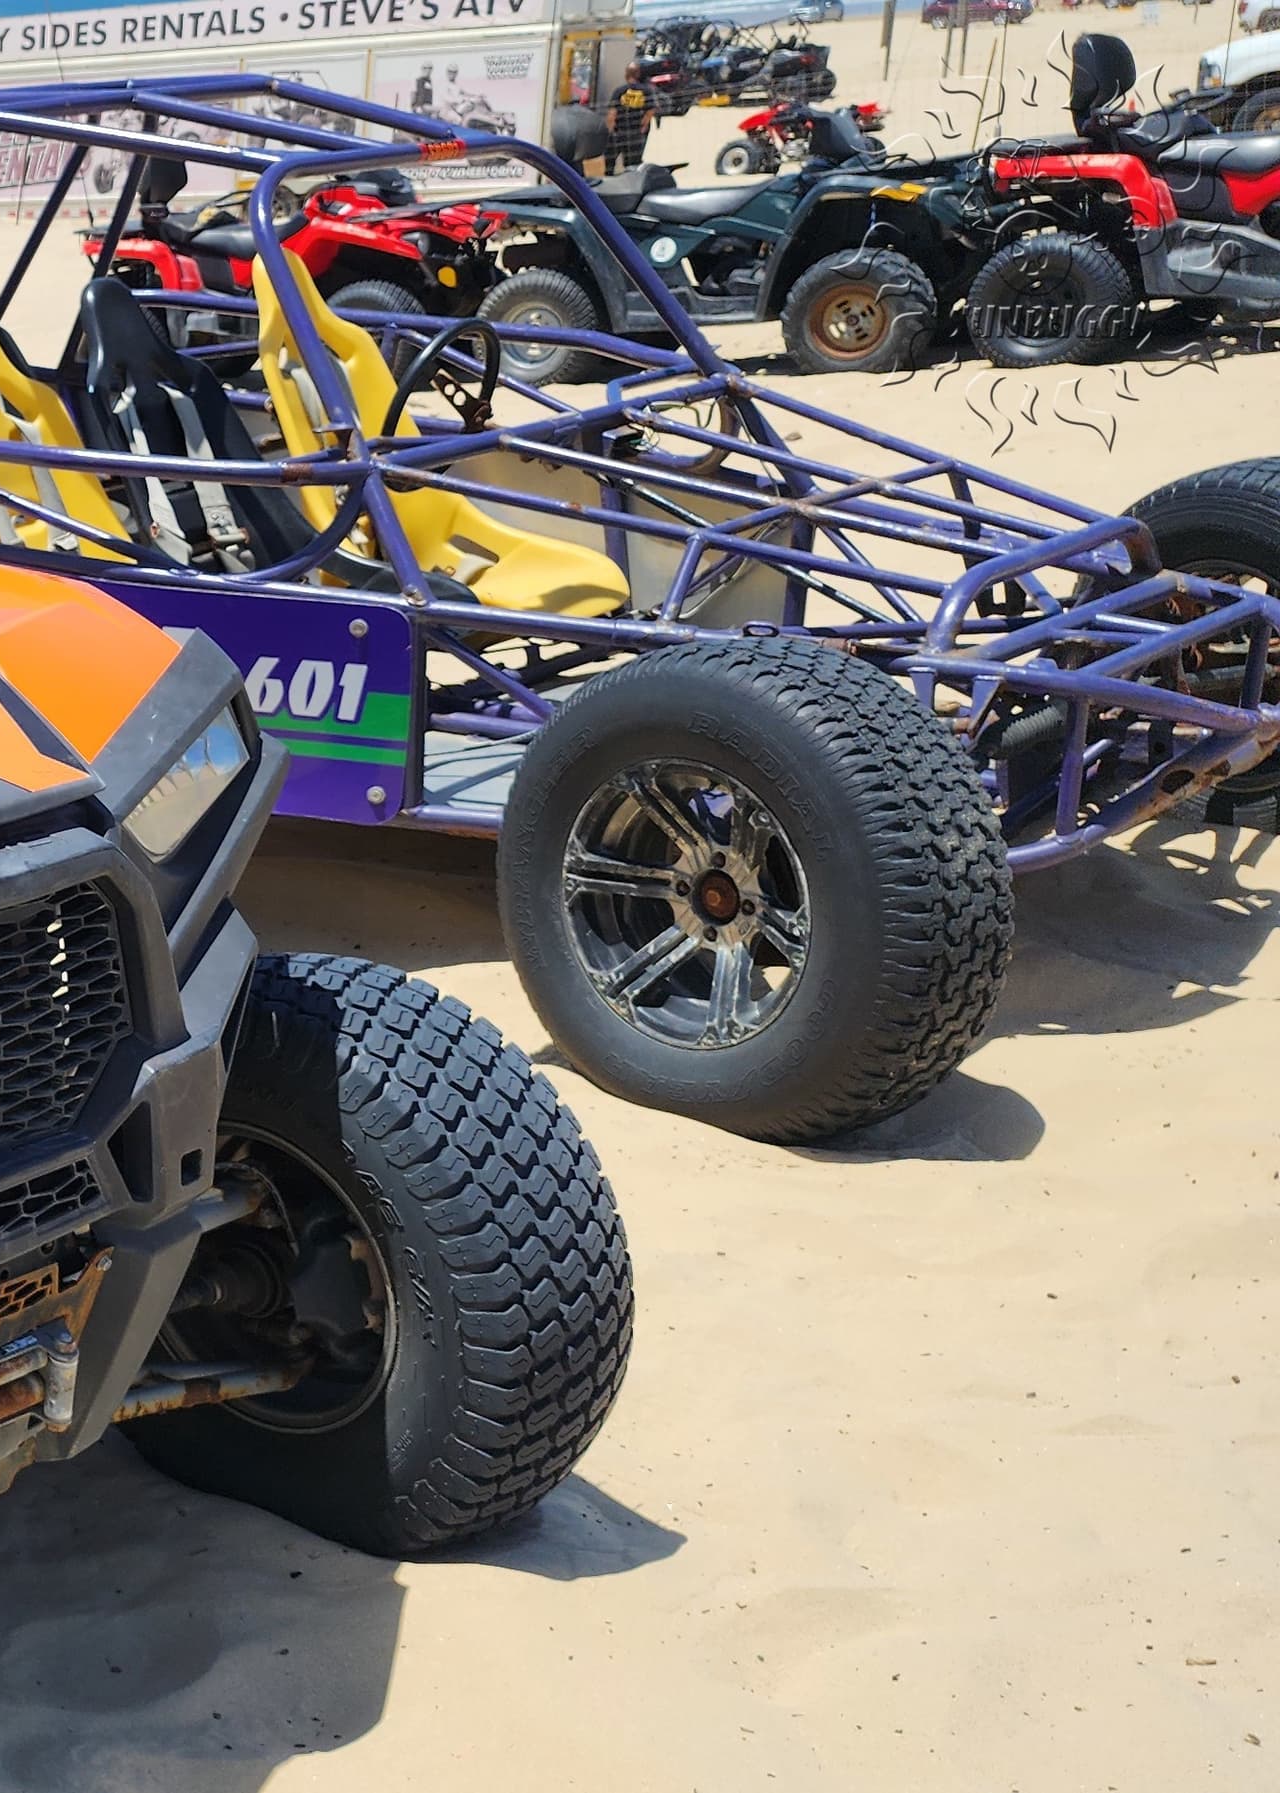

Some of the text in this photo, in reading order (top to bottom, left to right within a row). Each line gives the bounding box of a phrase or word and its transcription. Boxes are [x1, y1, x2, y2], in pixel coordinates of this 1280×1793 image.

[21, 19, 107, 51] SIDES
[121, 7, 265, 43] RENTALS
[244, 656, 368, 722] 601
